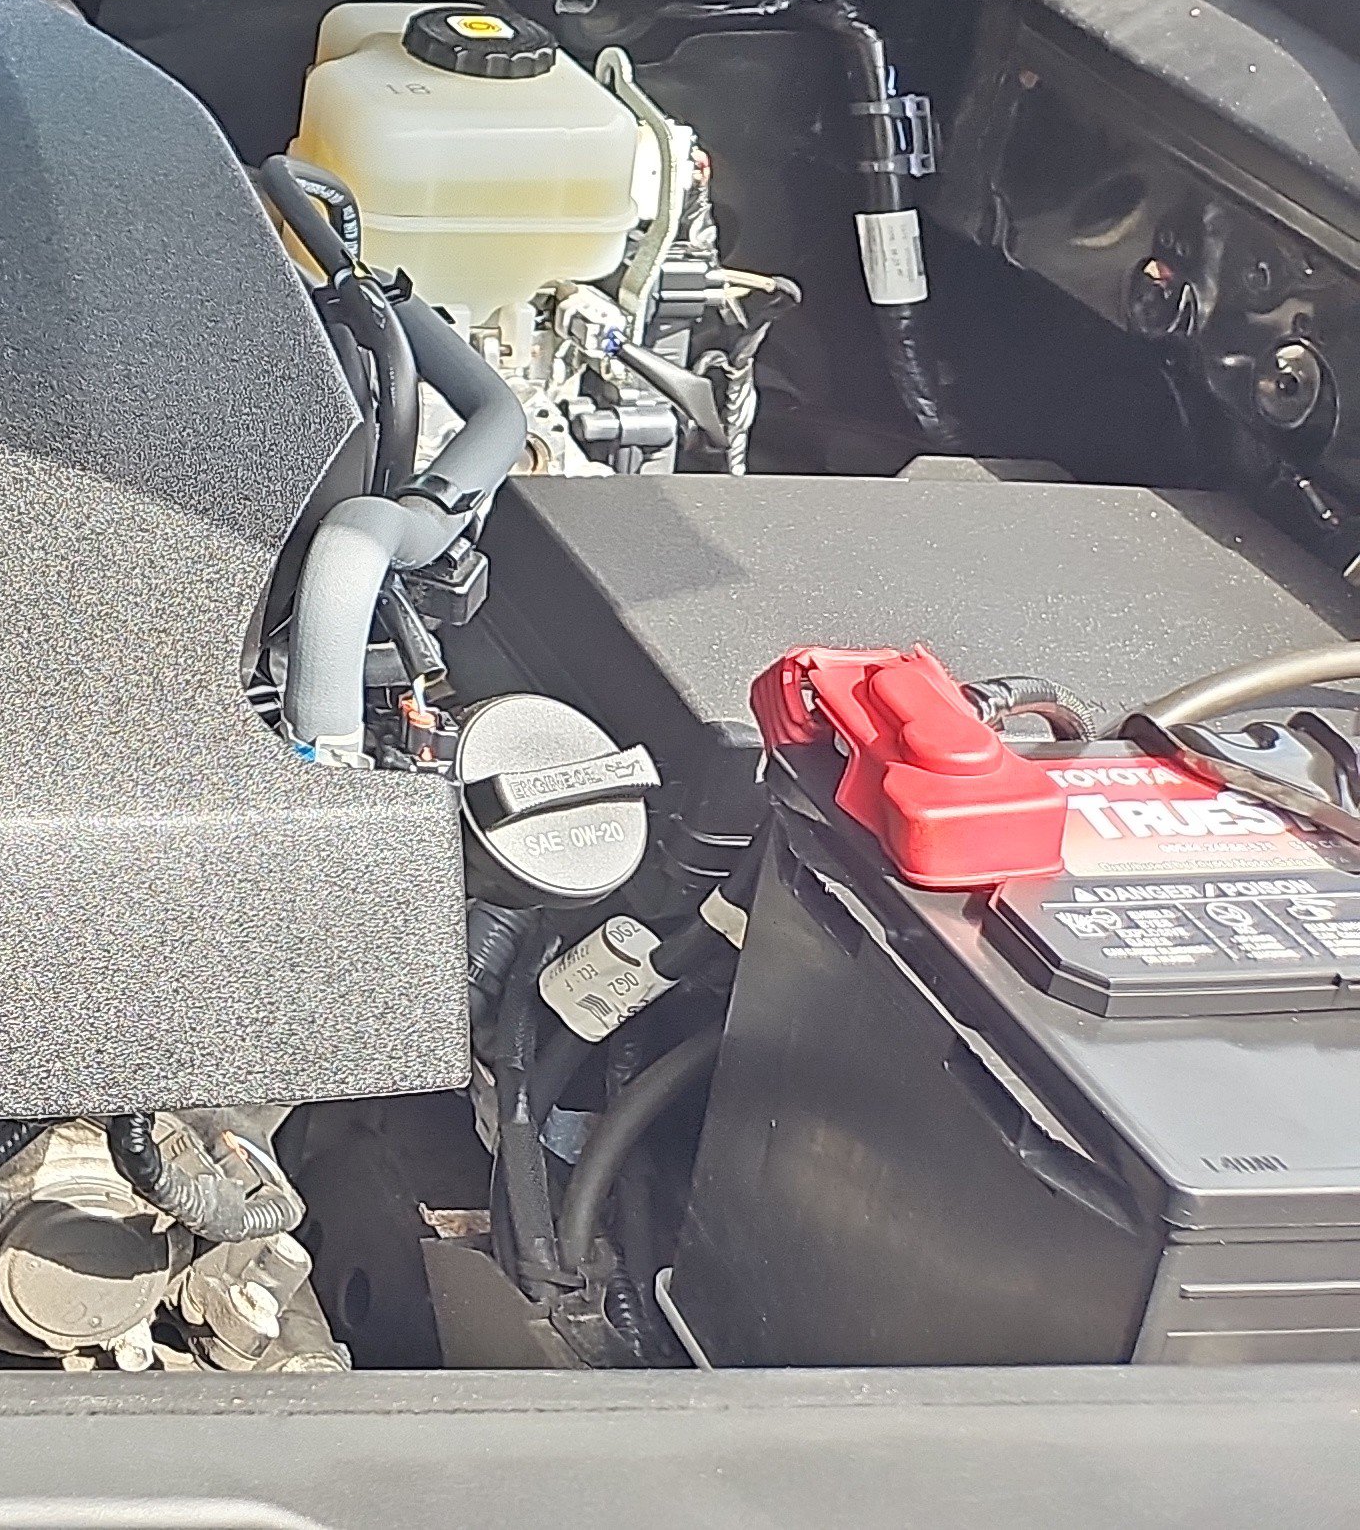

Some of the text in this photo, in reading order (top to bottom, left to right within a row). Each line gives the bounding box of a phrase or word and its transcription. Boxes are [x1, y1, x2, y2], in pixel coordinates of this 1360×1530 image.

[509, 771, 573, 801] ENGINE
[1046, 767, 1183, 789] TOYOTA
[1066, 791, 1290, 840] TRUES
[524, 830, 565, 857] SAE
[1094, 884, 1204, 902] DANGER
[1217, 879, 1318, 897] POISON
